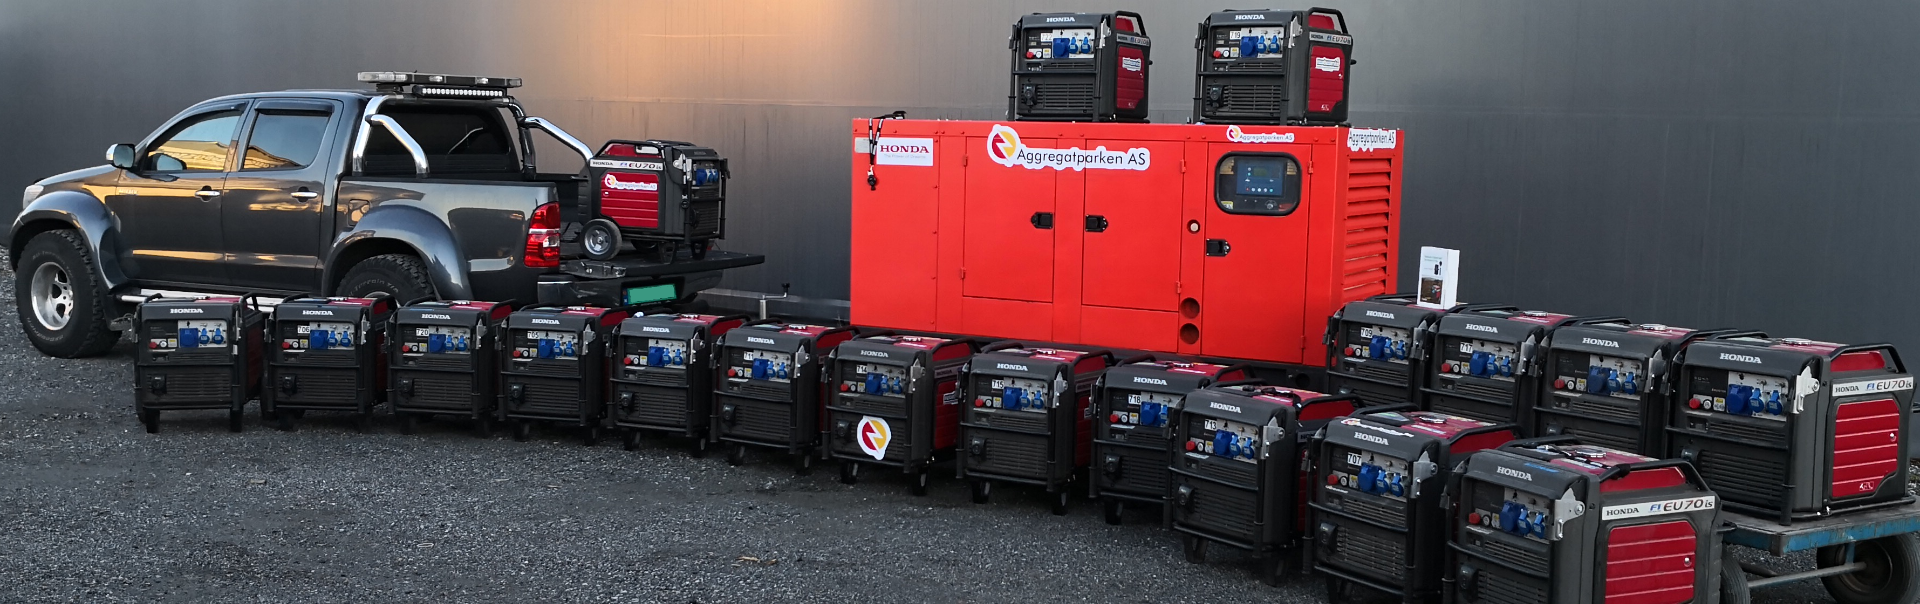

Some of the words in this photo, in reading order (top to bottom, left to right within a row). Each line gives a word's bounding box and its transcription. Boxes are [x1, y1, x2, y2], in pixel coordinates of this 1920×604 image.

[1239, 134, 1284, 142] Aggregatparken
[1348, 130, 1388, 147] Aggregatparken
[1388, 131, 1395, 144] AS
[880, 144, 930, 154] HONDA
[1017, 148, 1123, 166] Aggregatparken
[1127, 152, 1146, 166] AS
[1366, 311, 1395, 320] HONDA
[1361, 328, 1373, 338] 709
[1466, 323, 1499, 334] HONDA
[747, 336, 775, 345] HONDA
[1582, 337, 1620, 348] HONDA
[860, 350, 889, 358] HONDA
[1720, 352, 1762, 364] HONDA
[996, 363, 1028, 372] HONDA
[992, 380, 1004, 389] 715
[1133, 376, 1168, 386] HONDA
[1835, 385, 1860, 393] HONDA
[1129, 394, 1141, 404] 718
[1209, 401, 1242, 414] HONDA
[1205, 419, 1217, 430] 713
[1354, 431, 1390, 446] HONDA
[1348, 453, 1362, 465] 707
[1497, 465, 1533, 481] HONDA
[1606, 507, 1640, 516] HONDA
